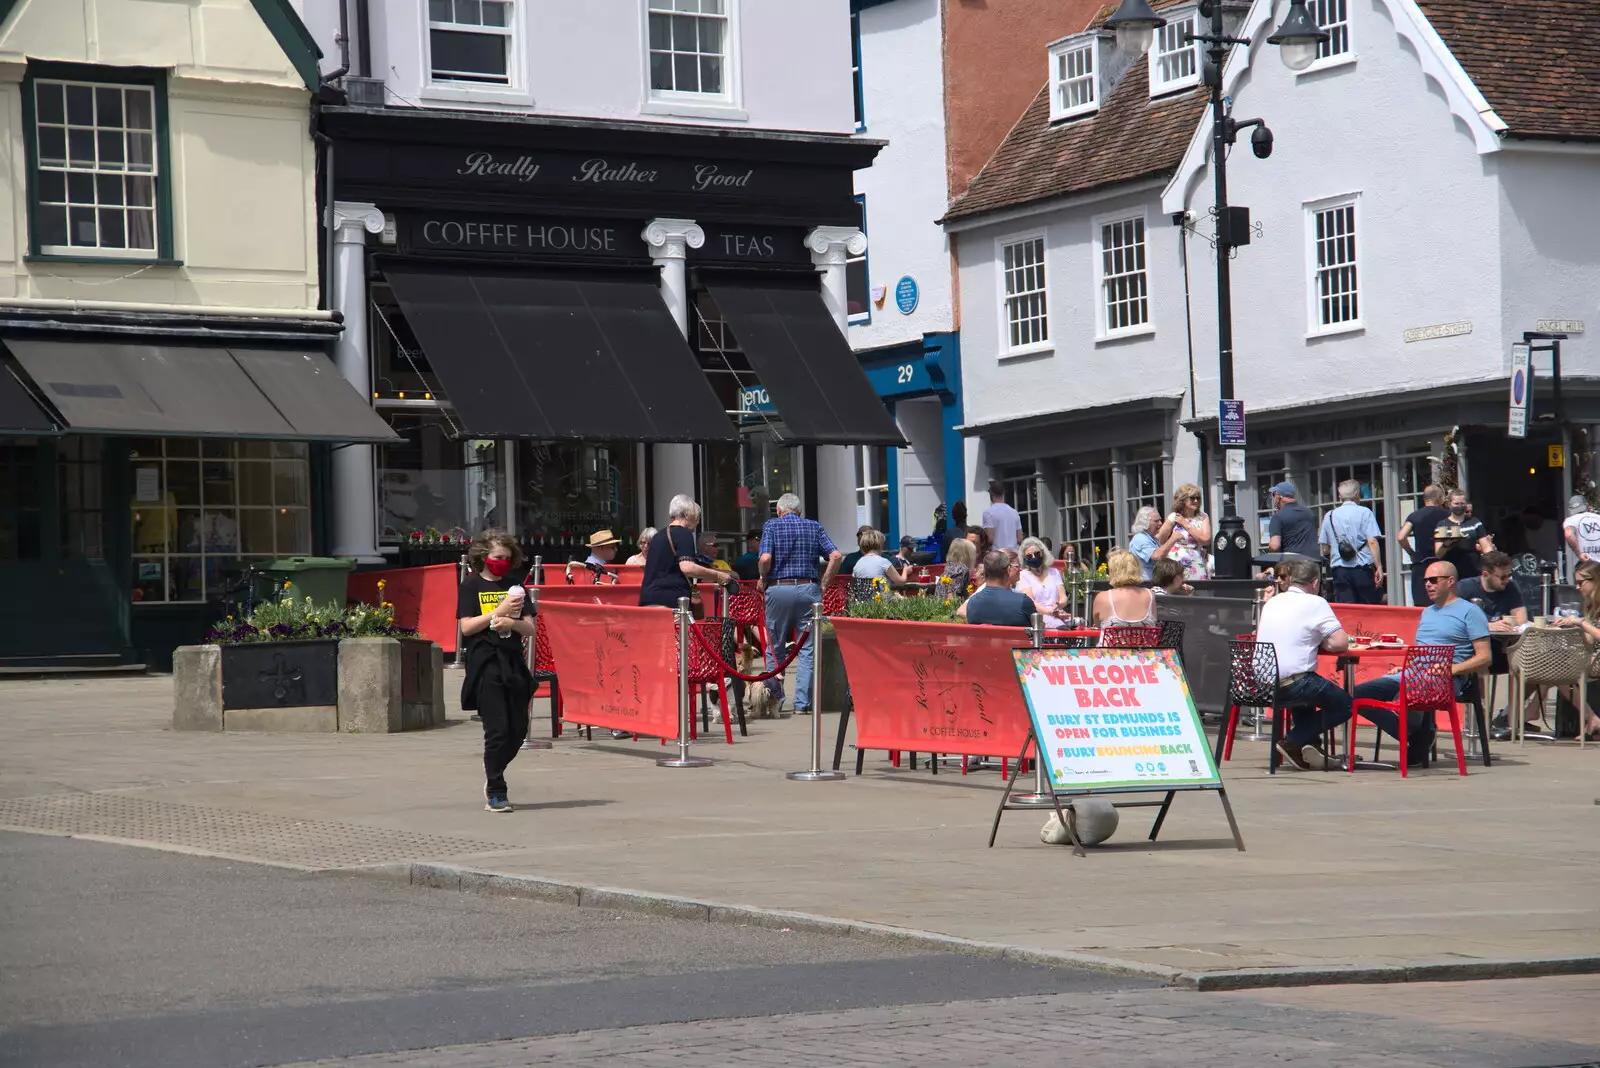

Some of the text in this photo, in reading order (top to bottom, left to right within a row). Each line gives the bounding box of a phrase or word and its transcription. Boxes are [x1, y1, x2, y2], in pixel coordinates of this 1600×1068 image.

[457, 152, 753, 191] Really Rather Good
[423, 220, 616, 251] COFFEE HOUSE
[720, 234, 774, 257] TEAS
[897, 364, 914, 384] 29
[1041, 664, 1159, 686] WELCOME
[1073, 687, 1142, 708] BACK
[1047, 711, 1181, 726] BURY ST EDMUNDS IS
[930, 726, 981, 738] COFFEE HOUSE
[1055, 725, 1182, 739] OPEN FOR BUSINESS
[1056, 743, 1194, 758] #BURYBOUNCINGBACK
